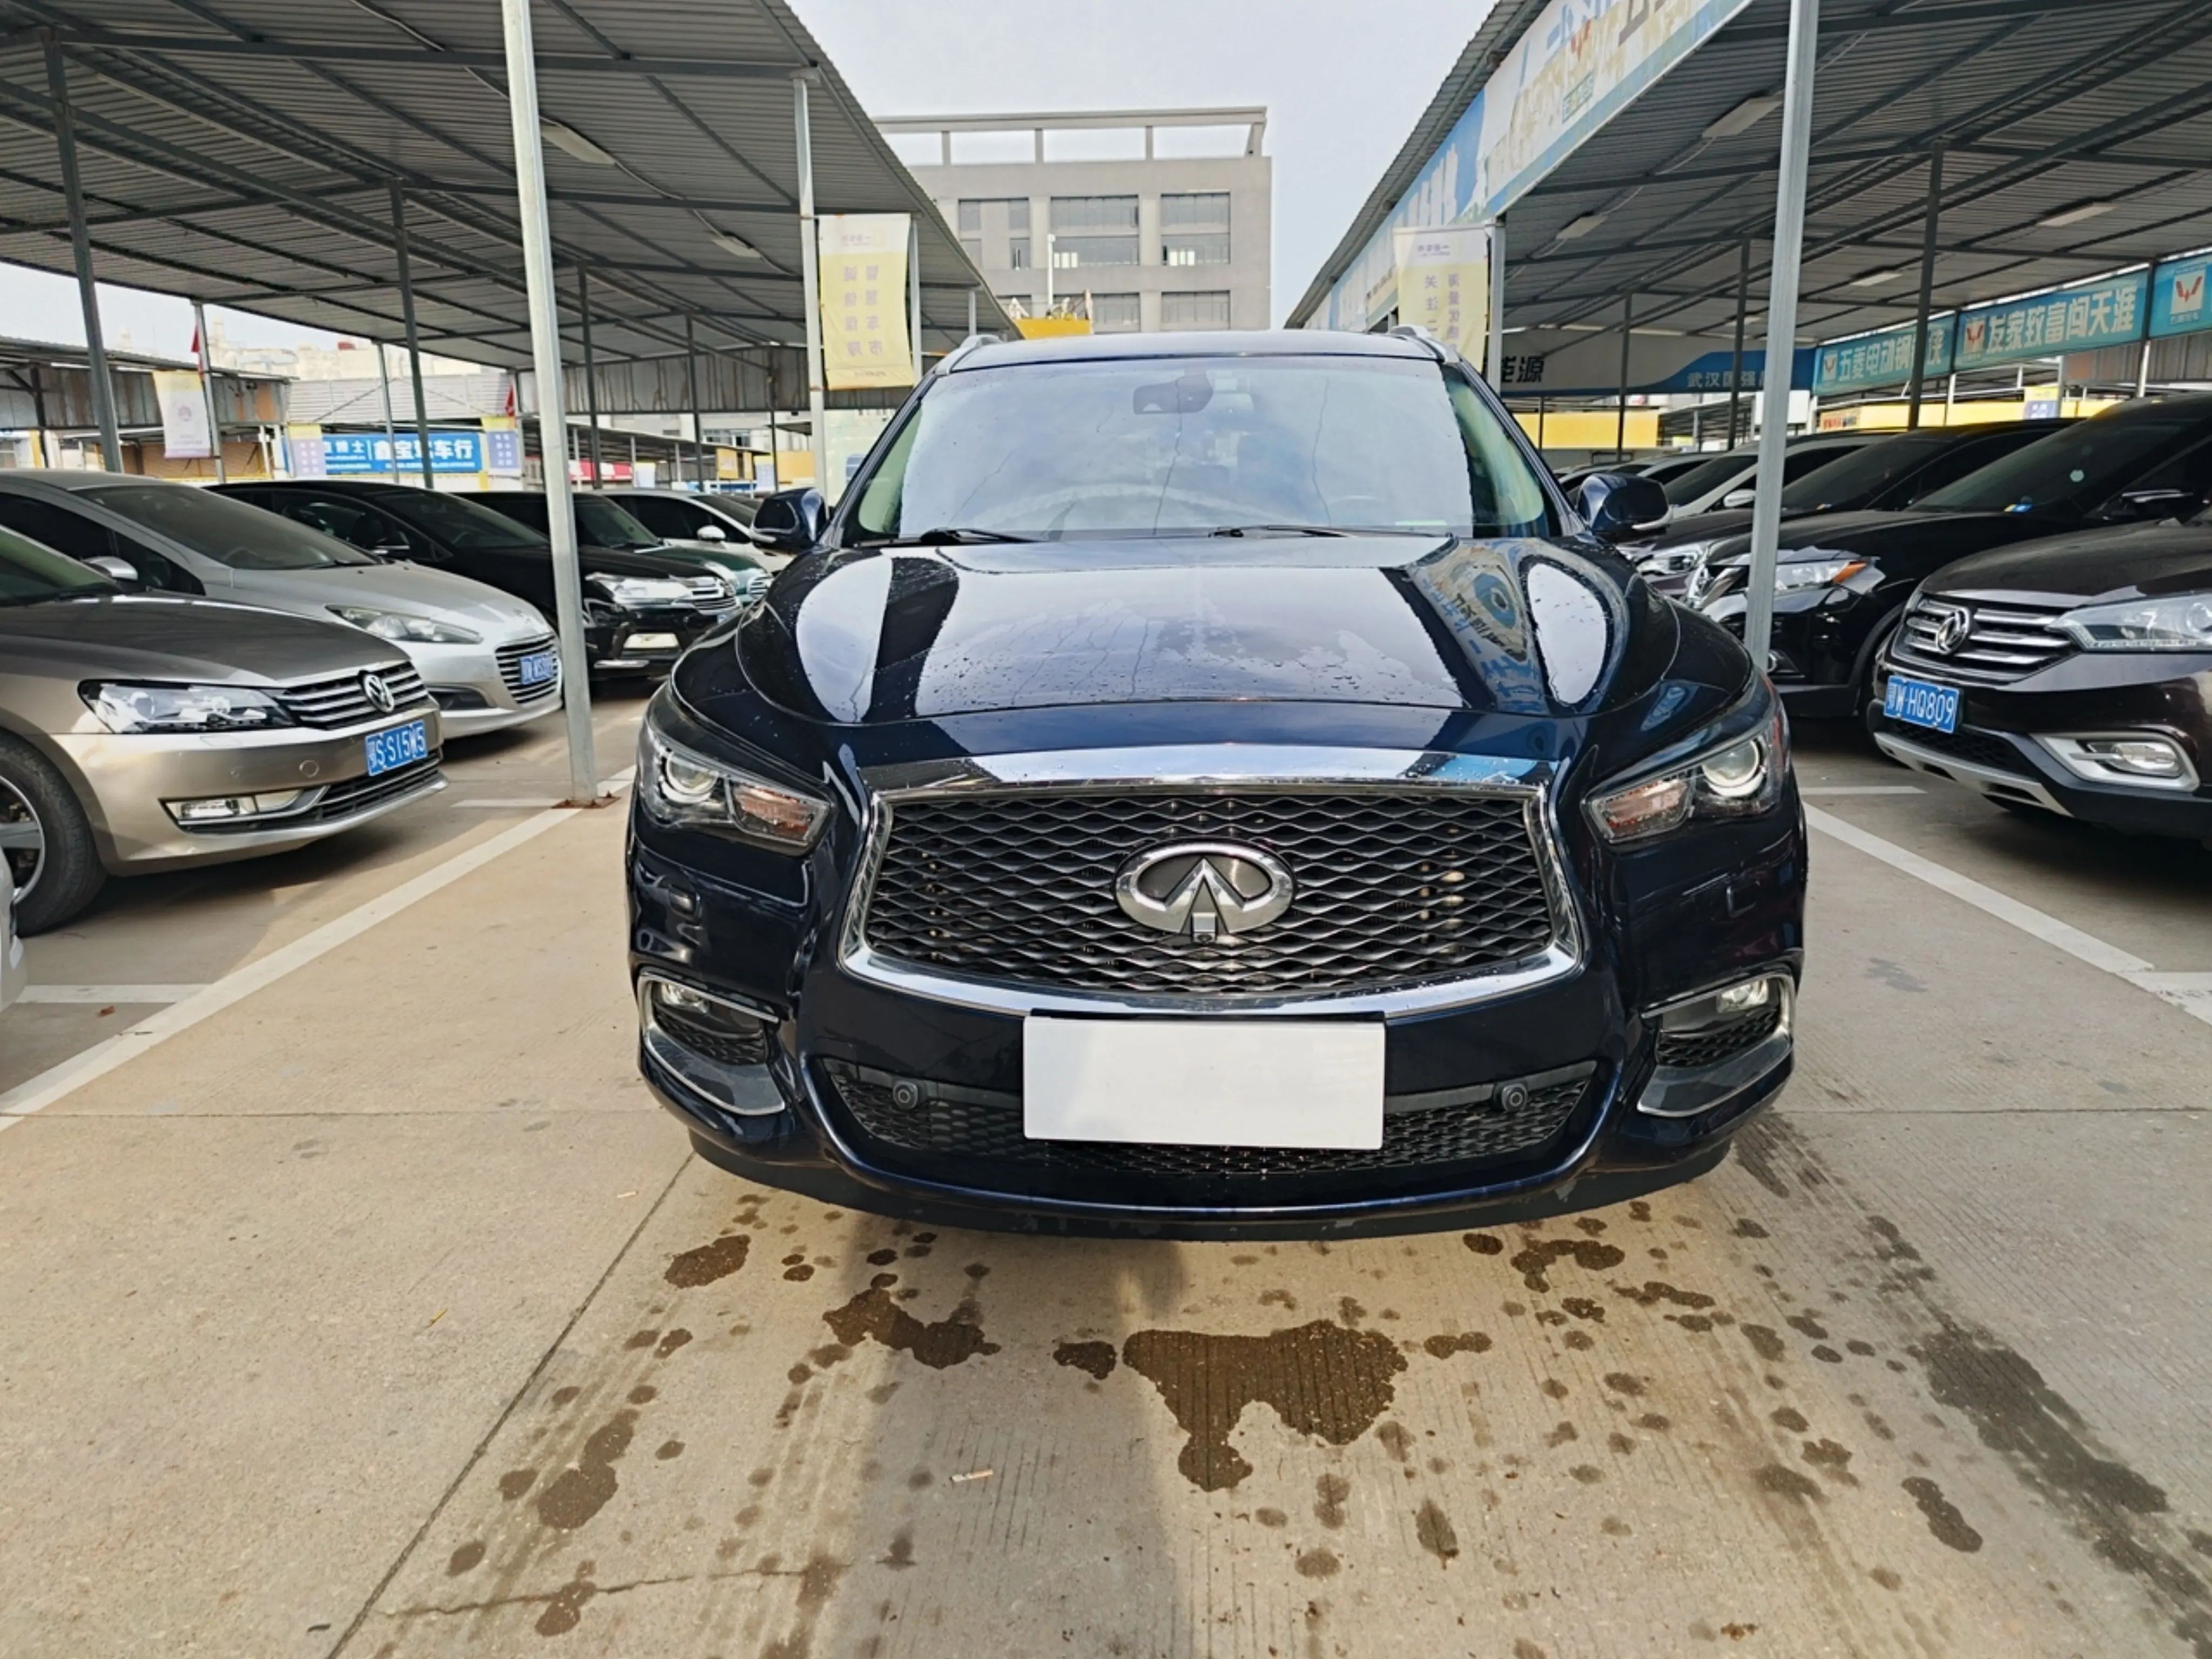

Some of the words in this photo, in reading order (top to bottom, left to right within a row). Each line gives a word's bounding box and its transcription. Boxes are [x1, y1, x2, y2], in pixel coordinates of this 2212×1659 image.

[1986, 285, 2137, 354] 发家致富闯天涯
